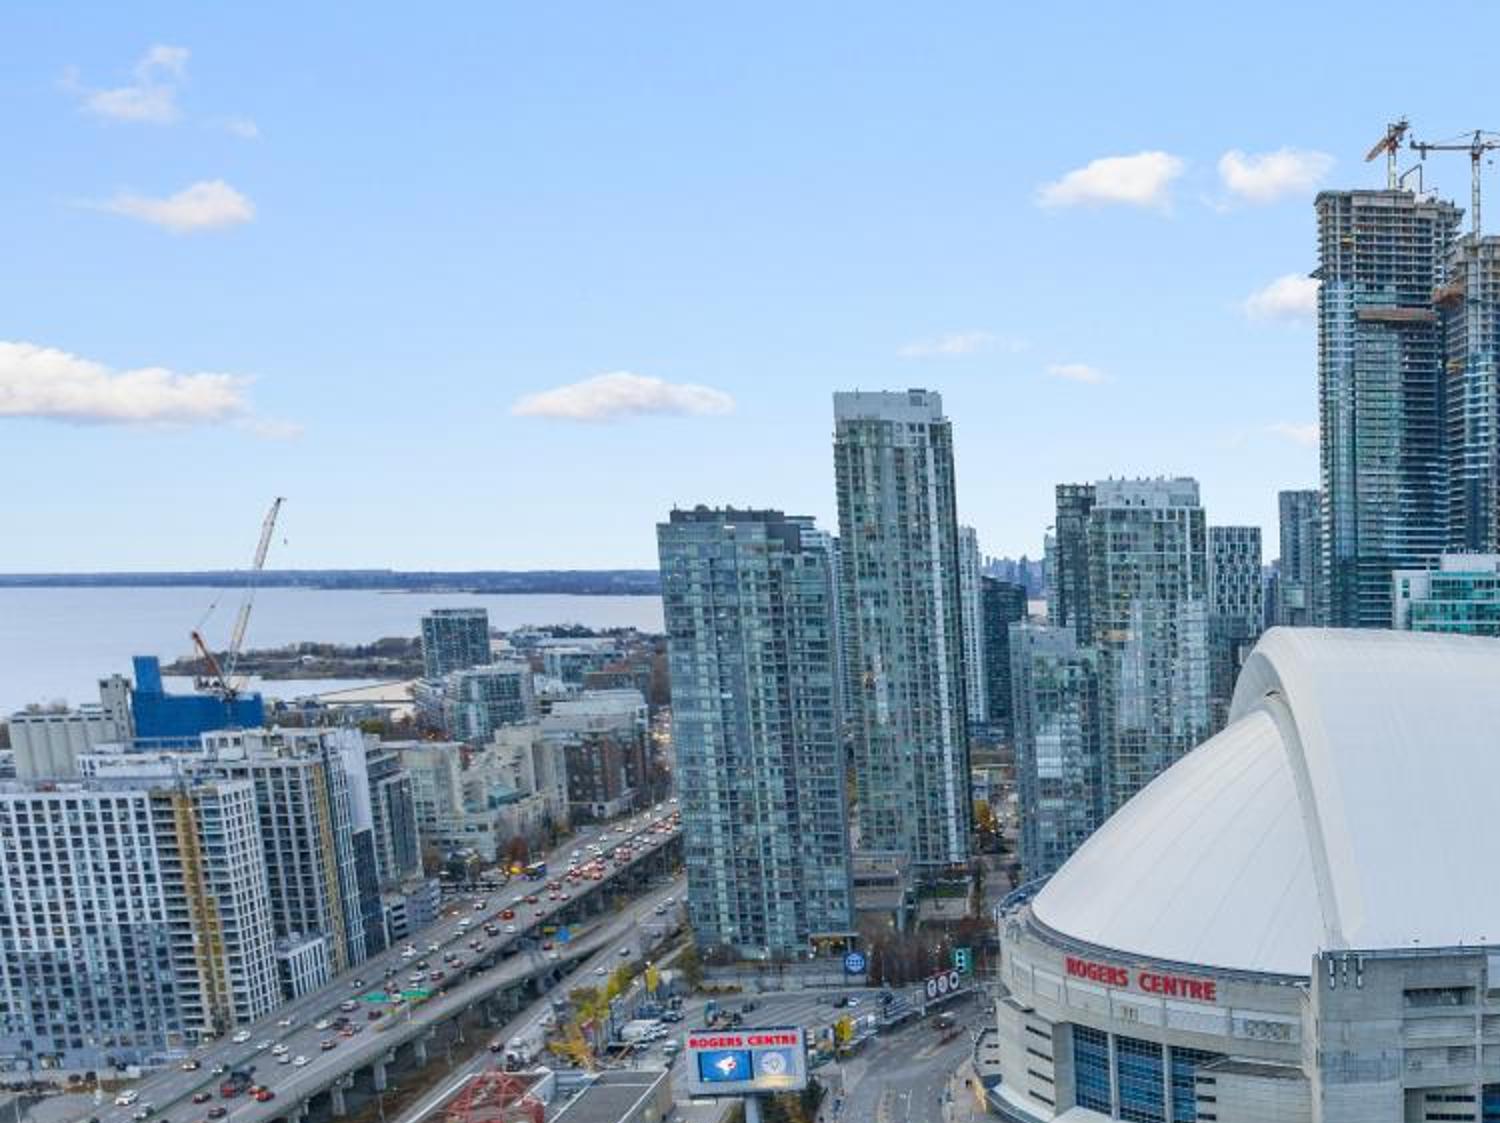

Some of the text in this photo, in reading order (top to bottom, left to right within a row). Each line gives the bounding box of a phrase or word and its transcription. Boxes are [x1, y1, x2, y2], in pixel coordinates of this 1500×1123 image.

[1066, 957, 1217, 1001] ROGERS CENTRE
[690, 1034, 797, 1048] ROGERS CENTRE
